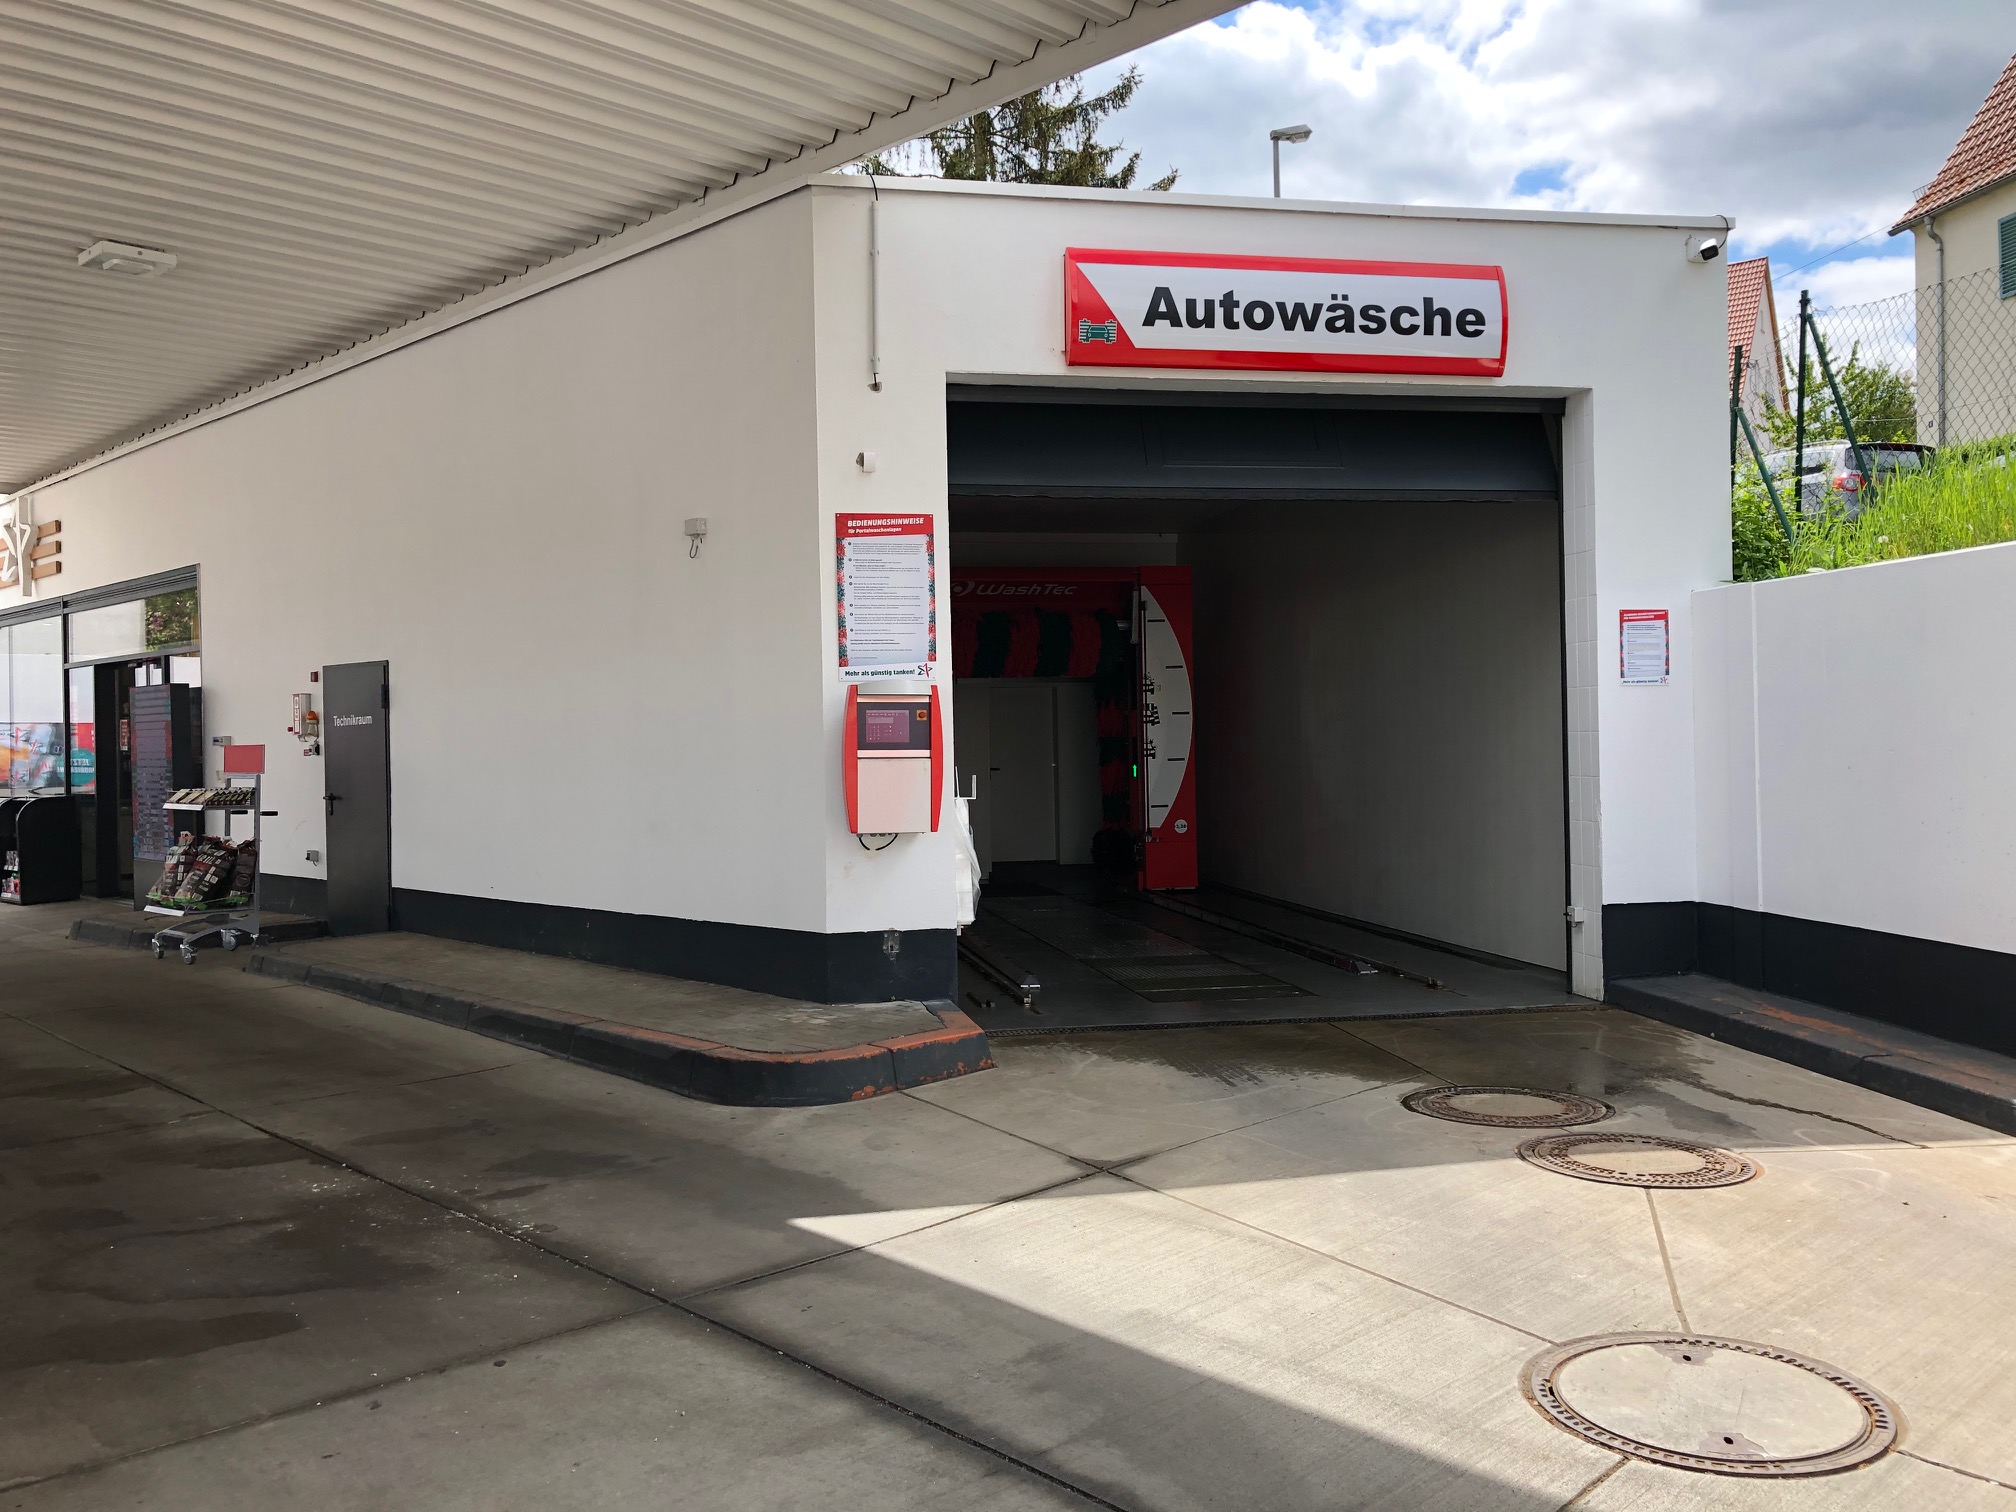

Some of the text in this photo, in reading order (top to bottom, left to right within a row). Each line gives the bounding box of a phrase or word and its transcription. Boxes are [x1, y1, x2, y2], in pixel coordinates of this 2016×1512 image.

[1142, 286, 1487, 338] Autowäsche
[847, 518, 924, 527] BEDIENUNGSHINWEISE
[870, 669, 892, 677] günstig
[333, 714, 372, 727] Technikraum
